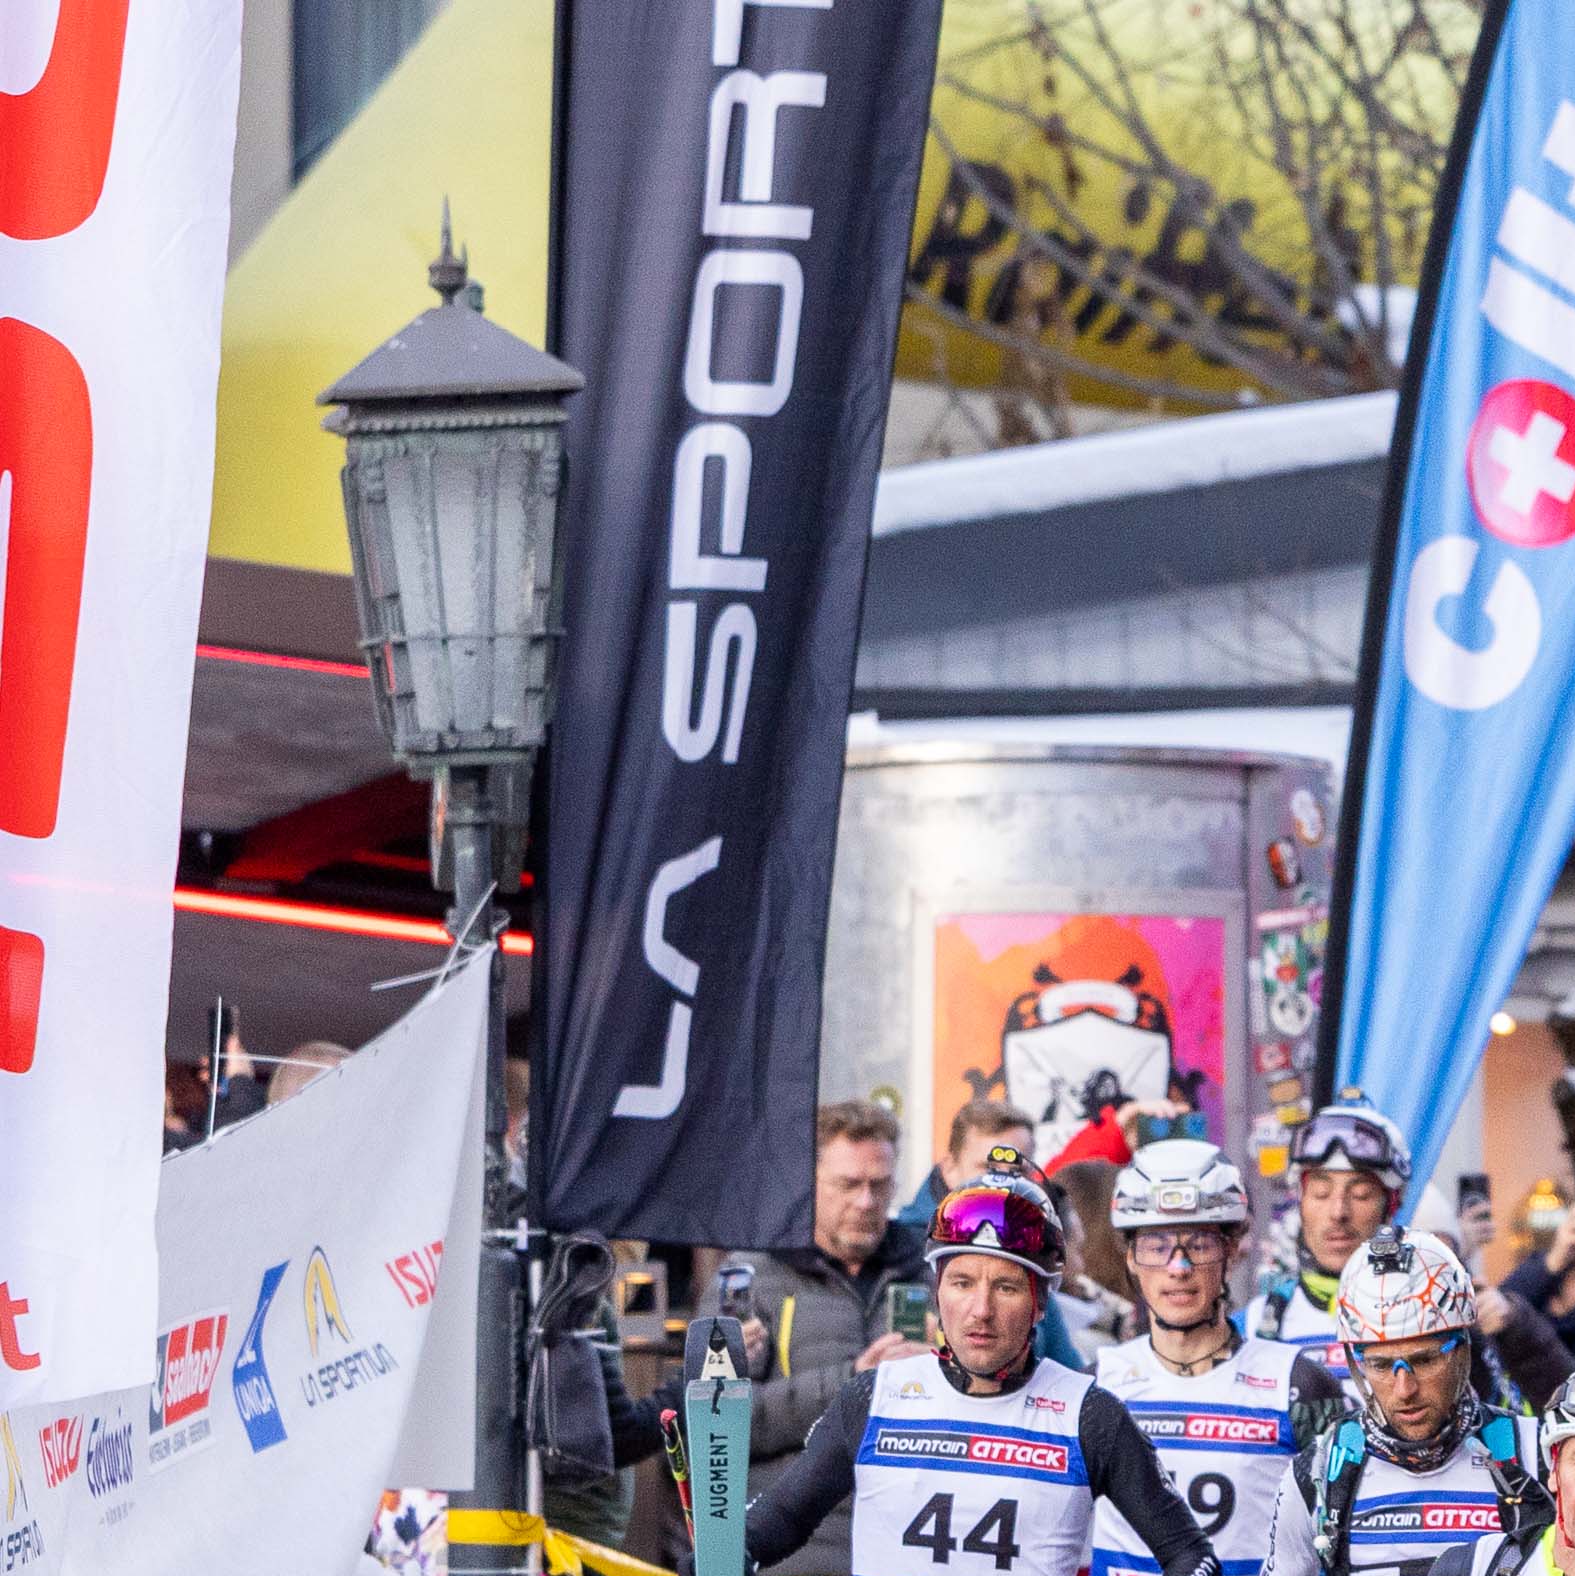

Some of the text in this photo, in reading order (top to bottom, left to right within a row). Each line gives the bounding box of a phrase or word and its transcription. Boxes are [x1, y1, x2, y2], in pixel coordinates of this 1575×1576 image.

[1187, 1419, 1275, 1441] attack
[879, 1435, 1063, 1468] mountain attack
[708, 1432, 730, 1521] AUGMENT
[901, 1491, 1020, 1571] 44
[1425, 1508, 1502, 1529] attac
